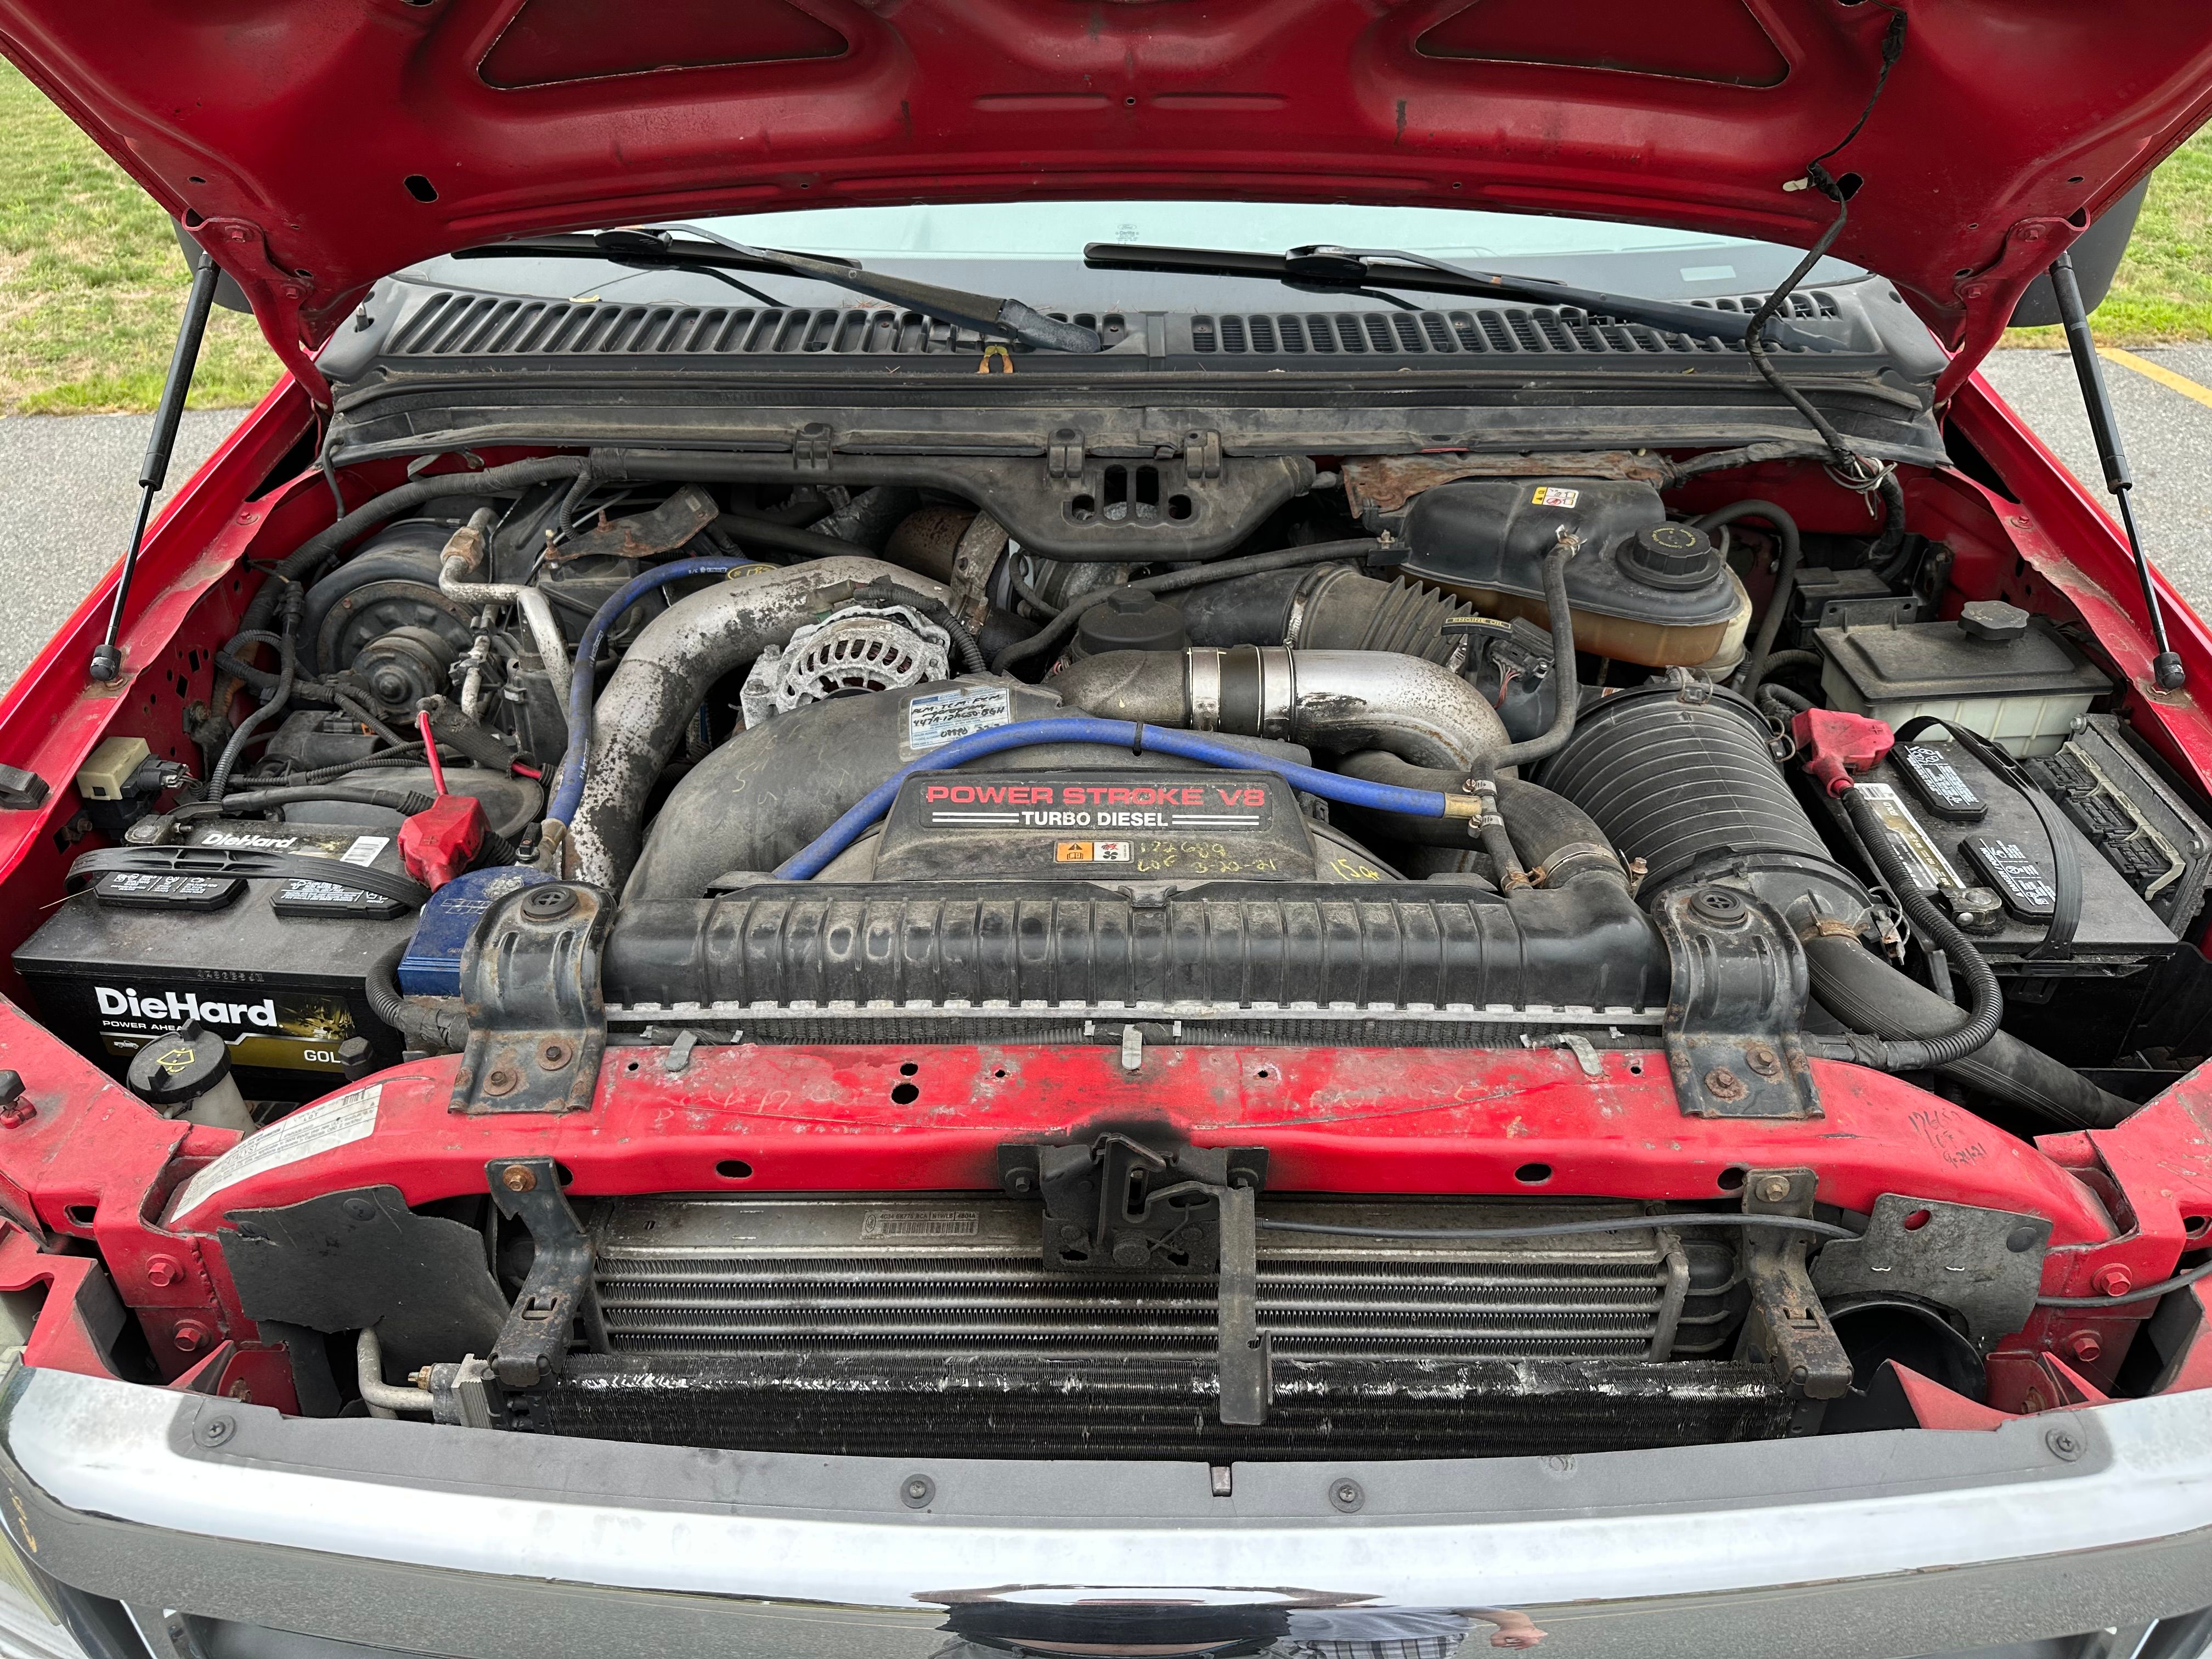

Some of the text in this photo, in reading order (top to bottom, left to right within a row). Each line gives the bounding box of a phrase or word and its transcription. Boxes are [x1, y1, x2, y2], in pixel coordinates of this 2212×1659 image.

[928, 786, 1266, 807] POWER STROKE V8
[1882, 802, 1899, 817] GOLD
[1021, 812, 1169, 828] TURBO DIESEL
[201, 833, 298, 848] DieHard
[1979, 847, 2002, 866] POISON
[1997, 870, 2024, 892] DANGER
[94, 986, 278, 1027] DieHard
[103, 1020, 146, 1029] POWER
[303, 1049, 341, 1063] GOL
